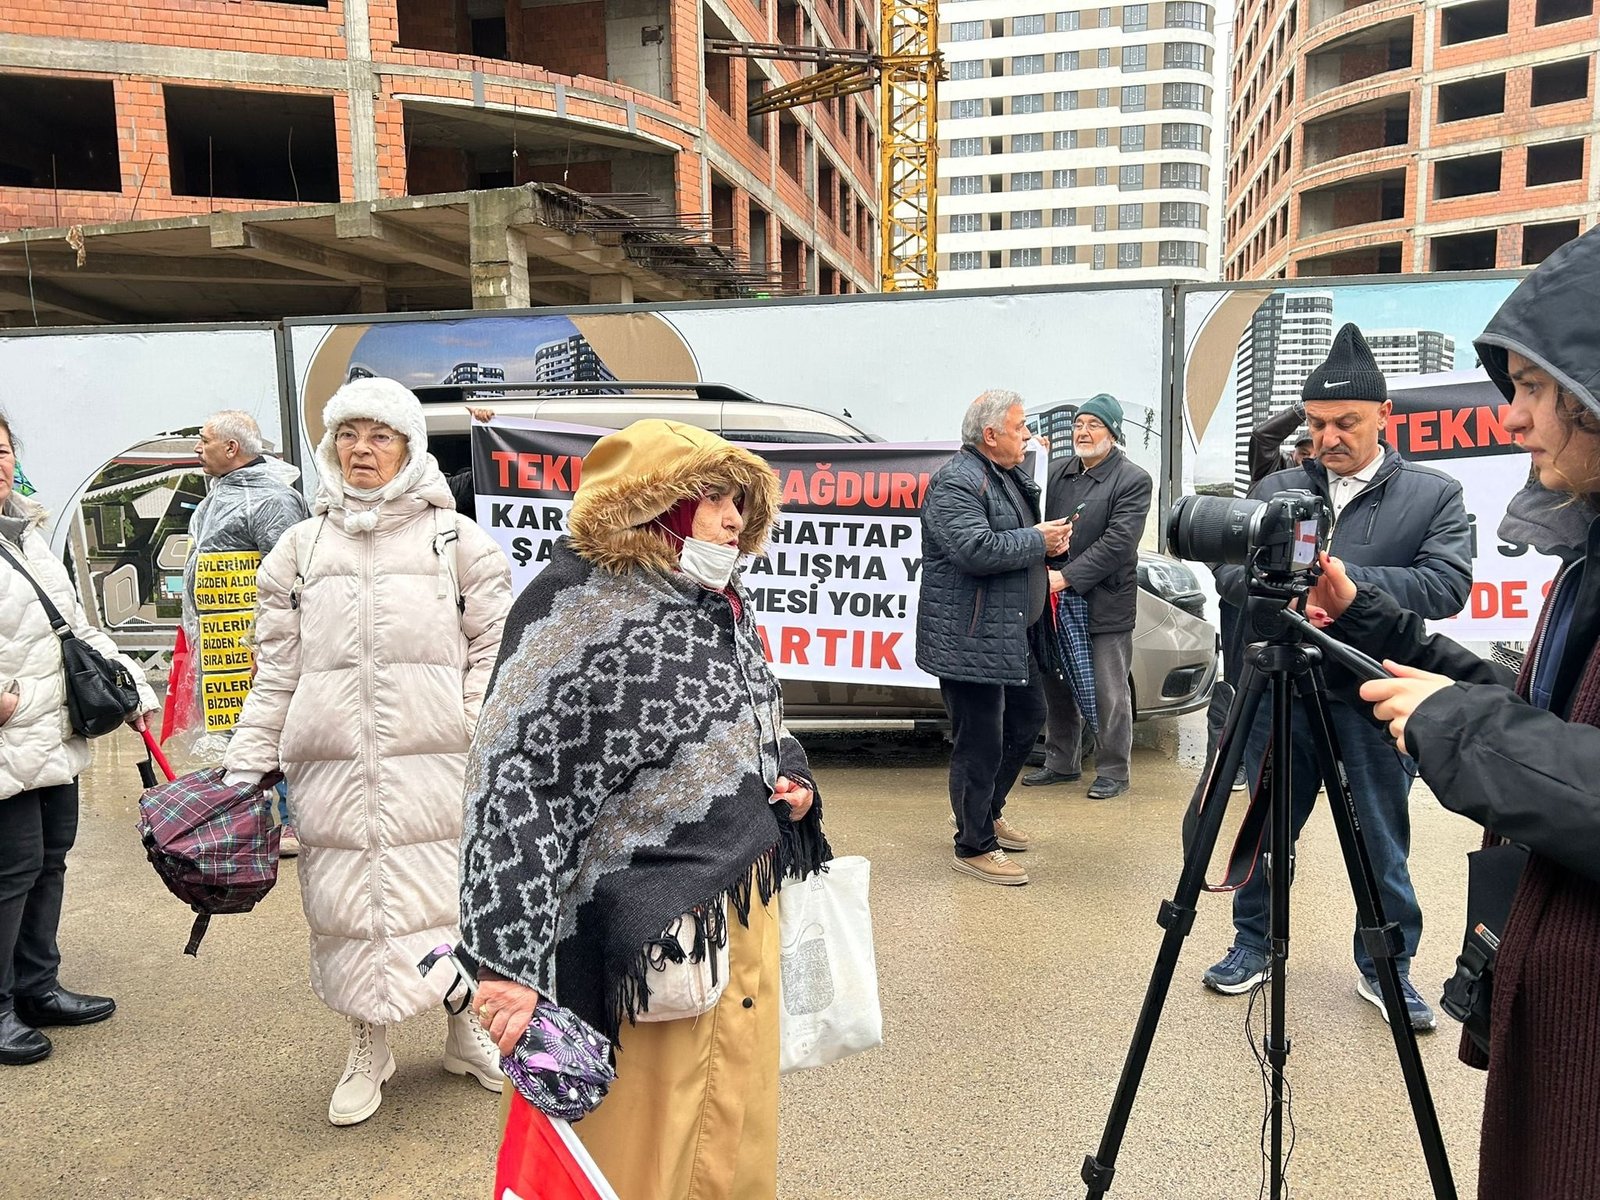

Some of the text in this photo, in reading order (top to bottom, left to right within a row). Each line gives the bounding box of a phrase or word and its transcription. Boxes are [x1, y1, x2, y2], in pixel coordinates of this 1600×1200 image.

[1385, 404, 1525, 453] TEKN
[772, 462, 930, 509] AĞDUR
[491, 503, 912, 548] KAR HATTAP
[739, 552, 887, 584] ALIŞMA
[196, 593, 216, 605] SIRA
[218, 590, 241, 605] BİZE
[828, 591, 907, 619] YOK!
[203, 637, 235, 650] BİZDEN
[203, 654, 223, 666] SIRA
[225, 651, 248, 665] BİZE
[207, 696, 244, 710] BİZDEN
[208, 711, 242, 726] SIRA B
